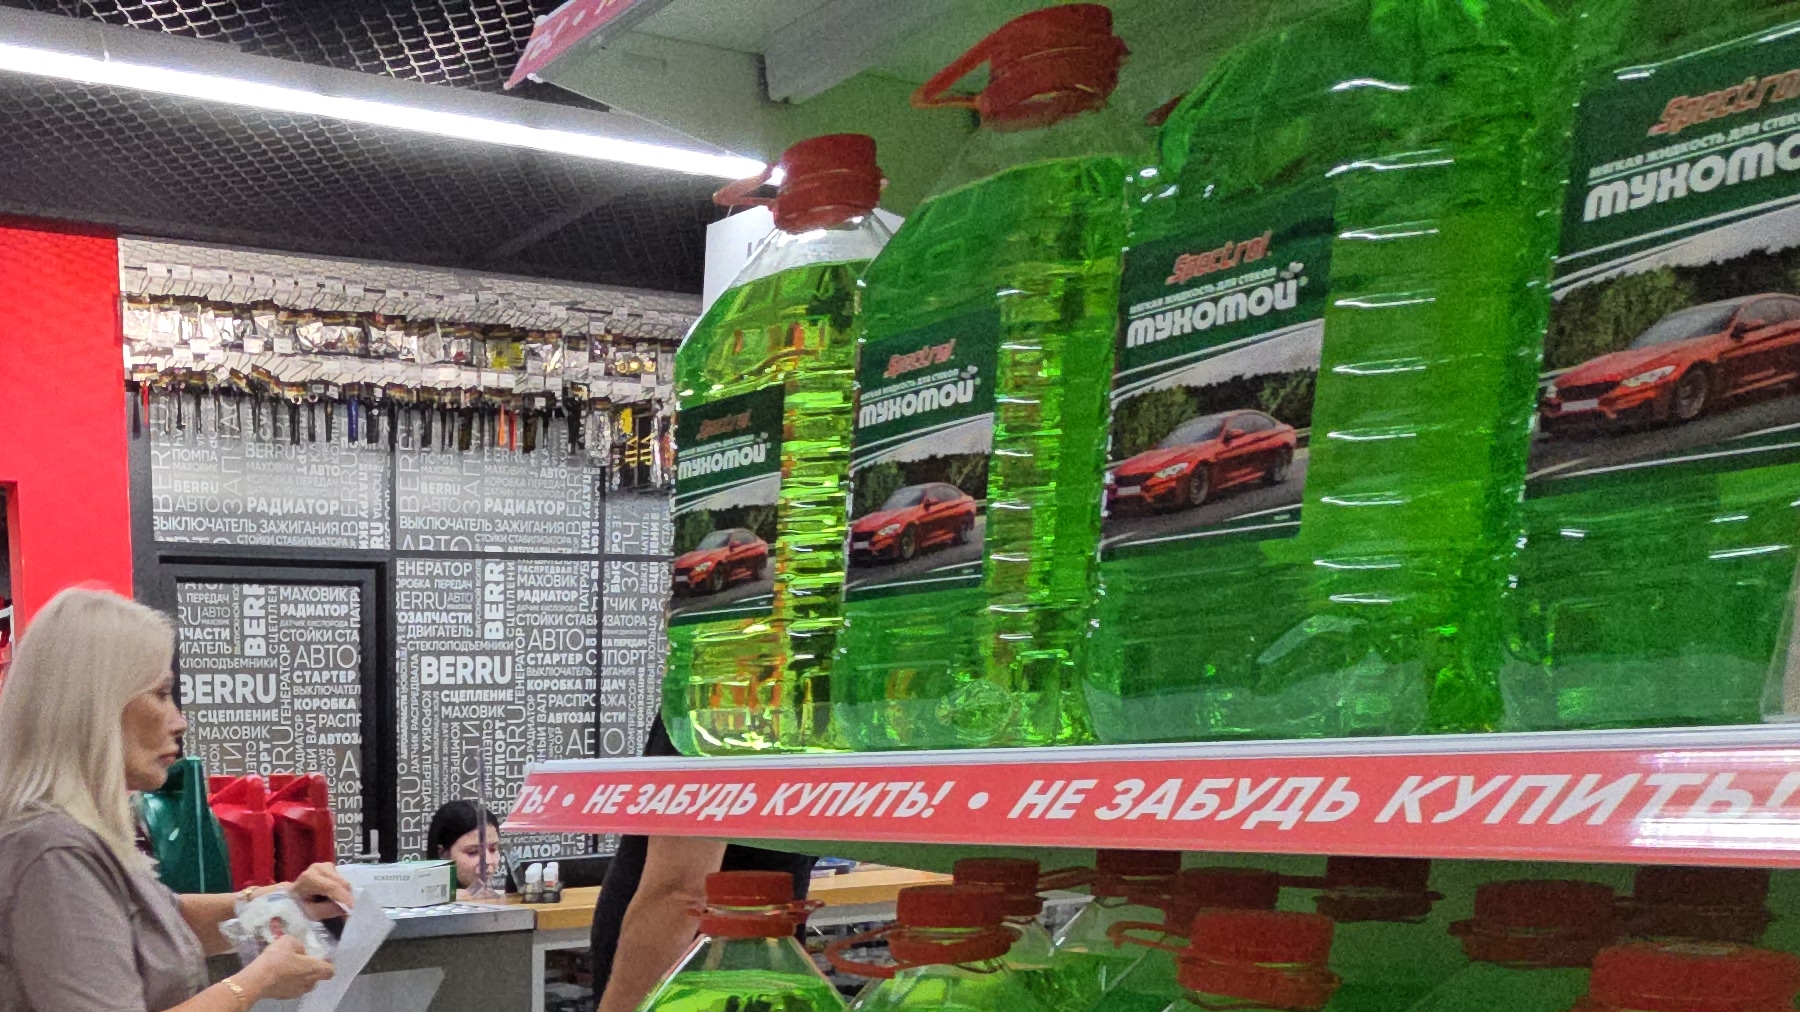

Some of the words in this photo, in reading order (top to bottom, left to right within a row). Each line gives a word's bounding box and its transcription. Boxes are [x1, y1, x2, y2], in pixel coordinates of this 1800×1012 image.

[309, 464, 341, 477] АВТО
[540, 468, 567, 479] АВТО
[173, 480, 219, 494] BERRU
[340, 452, 359, 536] BERRU
[420, 482, 460, 496] BERRU
[174, 497, 220, 513] АВТО
[247, 497, 339, 516] РАДИАТОР
[420, 498, 462, 513] АВТО
[484, 498, 566, 516] РАДИАТОР
[153, 515, 257, 534] ВЫКЛЮЧАТЕЛЬ
[260, 519, 340, 536] ЗАЖИГАНИЯ
[400, 515, 492, 533] ВЫКЛЮЧАТЕЛЬ
[494, 519, 565, 535] ЗАЖИГАНИЯ
[397, 561, 473, 577] ЕНЕРАТОР
[435, 578, 473, 589] ПЕРЕДАЧ
[517, 574, 578, 588] МАХОВИК
[186, 593, 230, 604] ПЕРЕДАЧ
[279, 587, 348, 602] МАХОВИК
[517, 590, 579, 603] РАДИАТОР
[202, 607, 230, 618] АВТО
[280, 603, 349, 618] РАДИАТОР
[516, 612, 563, 626] СТОЙКИ
[279, 627, 332, 642] СТОЙКИ
[407, 625, 474, 639] ДВИГАТЕЛЬ
[528, 628, 585, 651] АВТО
[648, 615, 657, 660] КОЛЬЦА
[407, 640, 514, 652] СТЕКЛОПОДЪЕМНИКИ
[293, 645, 358, 669] АВТО
[526, 653, 583, 666] СТАРТЕР
[421, 656, 512, 685] BERRU
[515, 628, 525, 703] ГЕНЕРАТОР
[526, 666, 592, 677] ВЫКЛЮЧАТЕЛЬ
[280, 644, 292, 725] ГЕНЕРАТОР
[293, 671, 357, 684] СТАРТЕР
[527, 678, 582, 691] КОРОБКА
[180, 674, 277, 704] BERRU
[440, 689, 513, 703] СЦЕПЛЕНИЕ
[294, 697, 357, 711] КОРОБКА
[198, 708, 279, 723] СЦЕПЛЕНИЕ
[441, 705, 506, 719] МАХОВИК
[627, 679, 637, 755] КОМПРЕССОР
[422, 690, 431, 751] КОРОБКА
[198, 725, 271, 741] МАХОВИК
[495, 720, 506, 798] СУППОРТ
[506, 705, 526, 798] BERRU
[422, 755, 431, 812] ПЕРЕДАЧ
[582, 783, 628, 815] НЕ
[625, 782, 758, 822] ЗАБУДЬ
[760, 780, 957, 820] КУПИТЬ!
[1007, 779, 1099, 820] НЕ
[1094, 774, 1363, 831] ЗАБУДЬ
